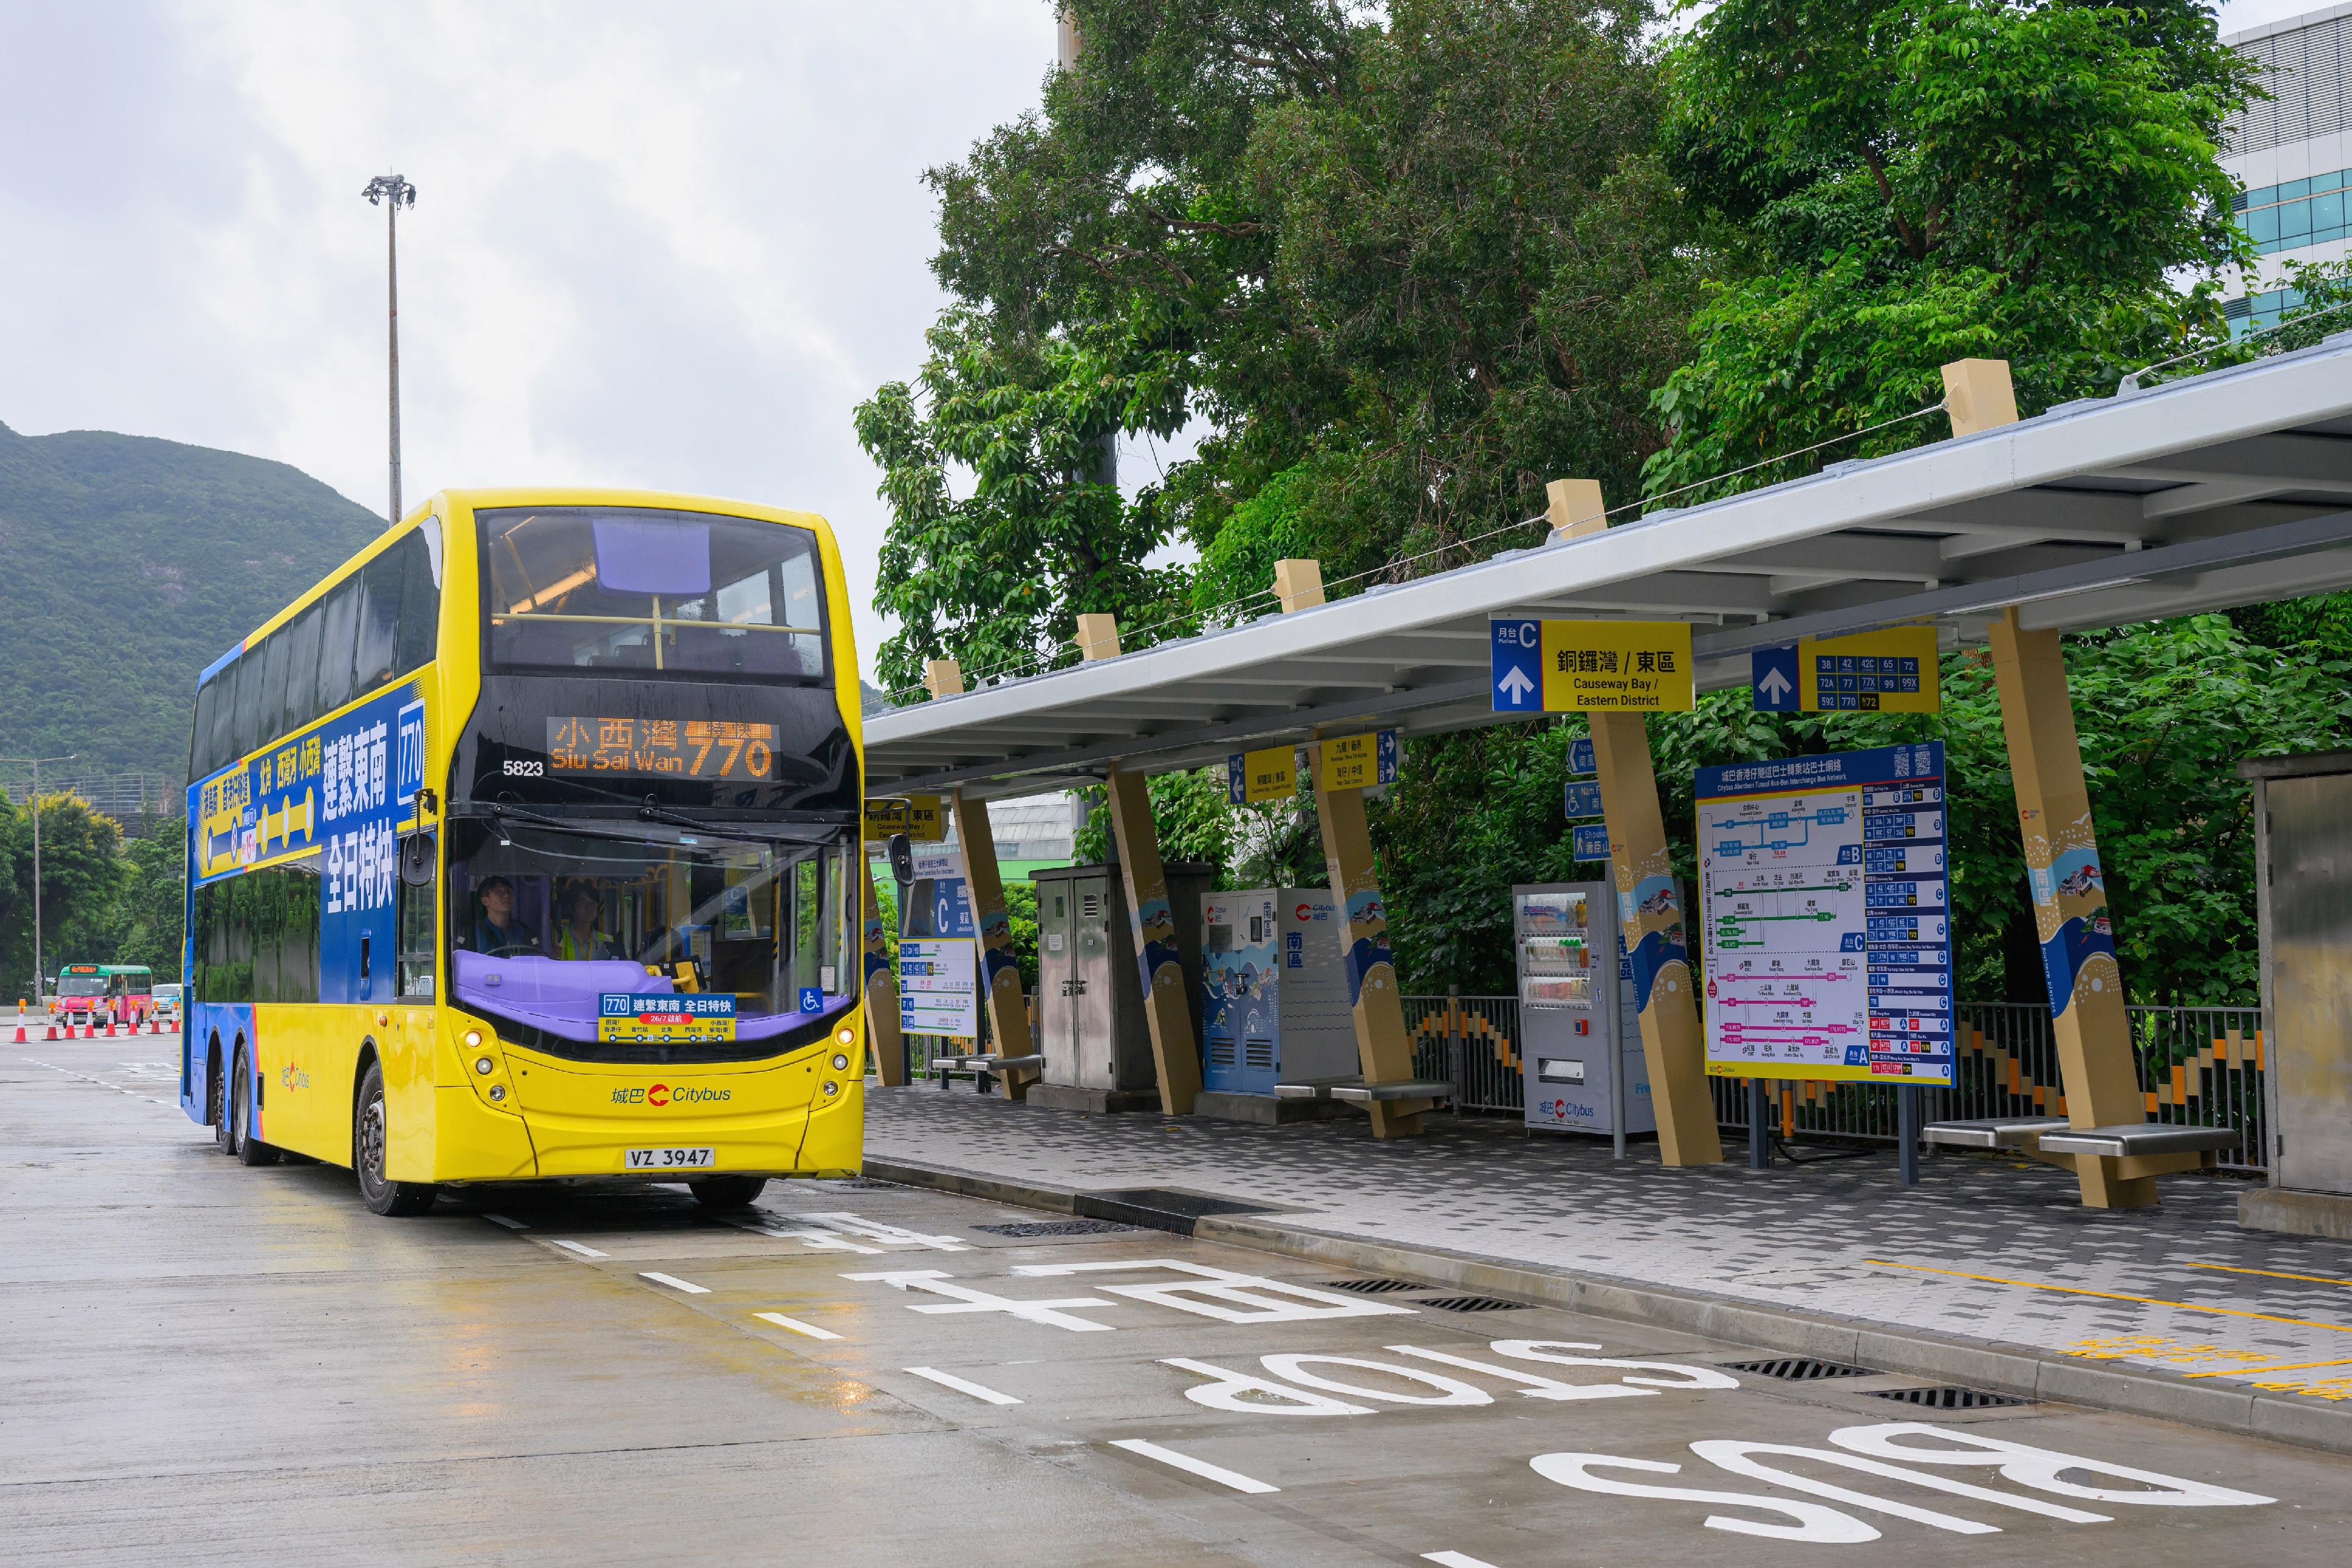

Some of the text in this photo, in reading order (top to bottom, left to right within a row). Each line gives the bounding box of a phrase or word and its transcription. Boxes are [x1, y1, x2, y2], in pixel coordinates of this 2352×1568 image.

[1498, 623, 1536, 648] 月台 C
[1557, 649, 1676, 673] 銅鑼灣 東區
[1822, 659, 1914, 671] 38 42 42C 65 72
[1573, 678, 1651, 692] Causeway Bay
[1820, 677, 1917, 688] 72A 77 77X 99 99X
[1577, 694, 1660, 706] Eastern District
[1822, 697, 1835, 706] 592
[1841, 697, 1856, 706] 770
[556, 717, 677, 751] 小西灣
[401, 718, 423, 787] 770
[1336, 740, 1362, 753] 九龍 新界
[1379, 744, 1385, 757] A
[1578, 743, 1592, 753] Nam
[299, 734, 321, 781] 小西灣
[551, 748, 681, 771] Siu Sai Wan
[688, 738, 772, 777] 770
[1237, 757, 1244, 772] C
[1578, 753, 1595, 768] 南風
[277, 745, 298, 791] 西灣河
[322, 719, 387, 823] 連繫東南
[503, 761, 543, 776] 5823
[1351, 764, 1362, 776] 中環
[1721, 758, 1842, 783] 城巴香港仔隧道巴士轉乘站巴士網絡
[259, 758, 272, 798] 北角
[1379, 770, 1385, 783] B
[1718, 774, 1847, 793] Citybus Aberdeen Tunnel Bus-Bus Interchange Bus Network
[1581, 787, 1595, 796] Nam
[912, 810, 934, 821] 東區
[1585, 840, 1609, 855] 壽臣山
[1852, 847, 1860, 862] B
[327, 816, 393, 914] 全日特快
[2034, 868, 2053, 907] 南區
[938, 898, 948, 933] C
[1312, 904, 1335, 912] Citybu
[960, 912, 970, 924] 東區
[1263, 901, 1272, 938] 南區
[1312, 912, 1328, 922] 城巴
[1286, 931, 1304, 969] 南區
[1855, 934, 1863, 950] C
[2042, 947, 2057, 1014] Southern District
[606, 998, 731, 1013] 770 連繫東南 全日特快
[668, 1015, 682, 1024] 啟航
[1859, 1048, 1868, 1064] A
[610, 1087, 731, 1104] 城巴 Citybus
[1539, 1100, 1594, 1118] 城巴 Citybus
[631, 1149, 710, 1166] VZ 3947
[1155, 1338, 1739, 1415] STOP
[1528, 1422, 2278, 1542] BUS
